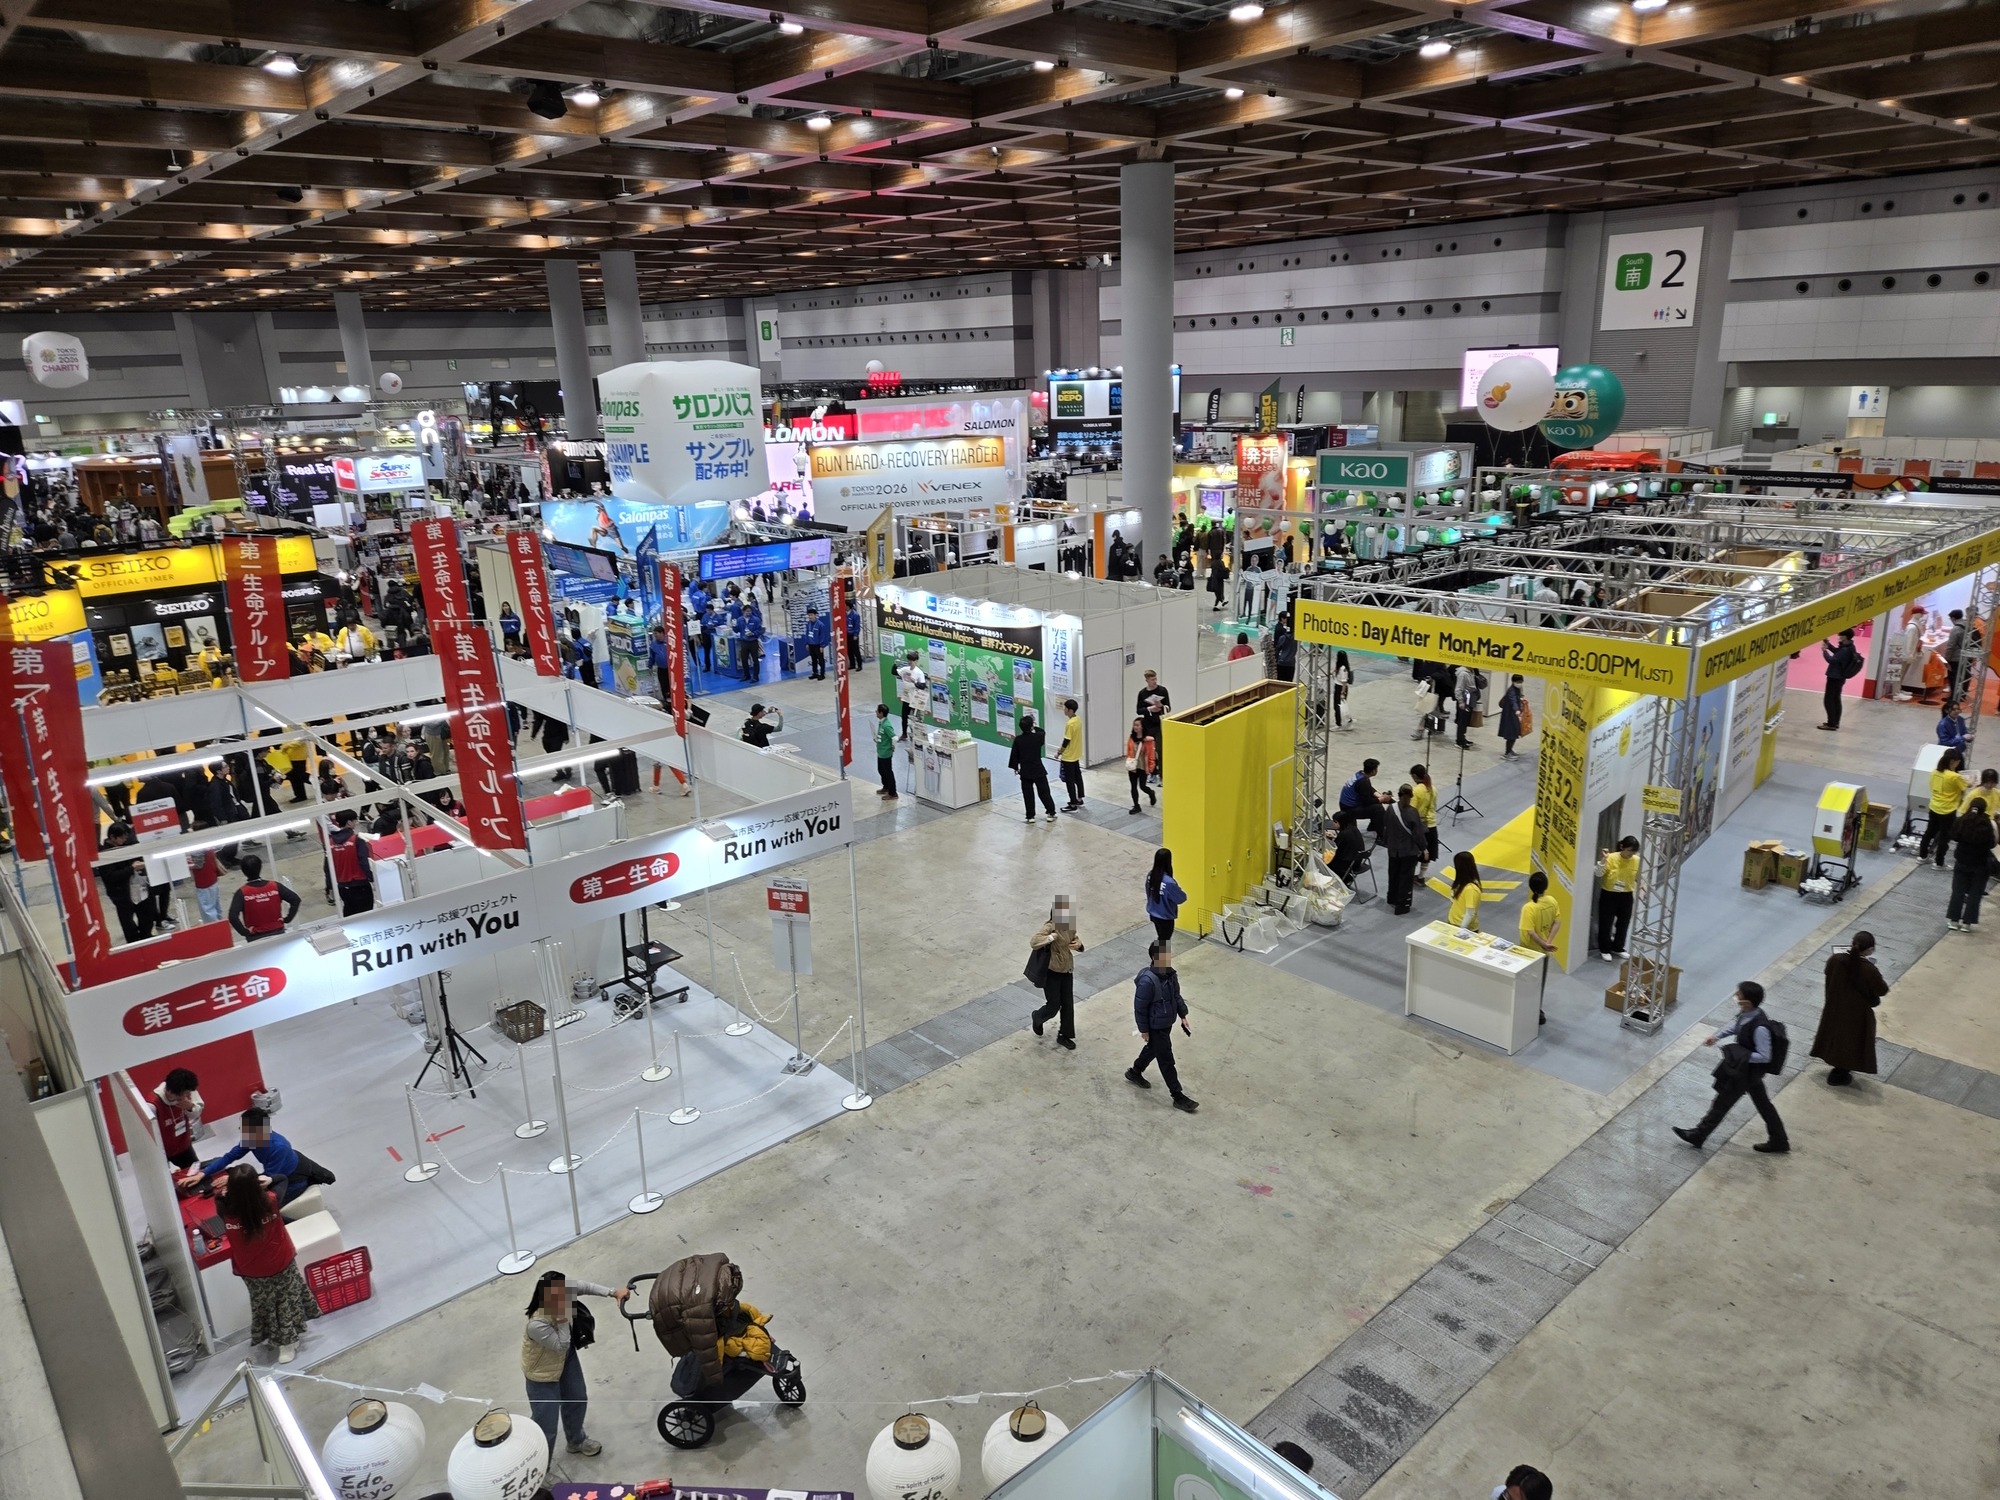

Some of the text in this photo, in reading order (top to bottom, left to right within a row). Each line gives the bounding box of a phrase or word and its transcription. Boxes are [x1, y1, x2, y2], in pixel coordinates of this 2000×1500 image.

[1626, 257, 1644, 265] South
[1661, 249, 1686, 288] 2
[1625, 267, 1642, 287] 南
[42, 364, 80, 372] CHARITY
[673, 392, 754, 420] サロンパス
[1058, 394, 1083, 402] DEPO
[600, 400, 640, 421] lonpas
[963, 418, 1016, 432] SALOMON
[764, 426, 844, 443] LOMON
[686, 437, 755, 461] サンプル
[1248, 446, 1279, 465] 発汗
[380, 462, 411, 472] SUPER
[816, 445, 999, 473] RUN HARD RECOVERY HARDER
[286, 463, 315, 477] Real
[317, 463, 334, 475] En
[369, 470, 408, 479] SPORTS
[695, 459, 749, 481] 配布中!
[930, 481, 982, 492] VENEX
[1752, 475, 1785, 483] MARATHON
[876, 483, 908, 495] 2026
[840, 495, 984, 512] OFFICIAL RECOVERY WEAR PARTNER
[619, 510, 669, 525] Salonpas
[89, 556, 171, 577] SEIKO
[93, 574, 175, 589] OFFICIAL TIMER
[281, 585, 321, 598] ROSPEX
[12, 600, 50, 624] IKO
[155, 599, 209, 616] SEIKO
[238, 541, 276, 677] 第一生命グループ
[903, 621, 923, 633] World
[923, 624, 952, 639] Marathon
[952, 630, 975, 645] Majors
[981, 637, 1034, 656] 世界7大マラソン
[1302, 612, 1350, 636] Photos
[1362, 620, 1389, 646] Day
[1391, 624, 1431, 648] After
[1512, 642, 1525, 662] 2
[1525, 651, 1566, 668] Around
[1705, 644, 1747, 678] OFFICIAL
[1749, 633, 1779, 660] PHOTO
[1779, 615, 1817, 646] SERVICE
[1854, 593, 1875, 615] Photos
[1643, 799, 1679, 810] Reception
[735, 801, 840, 838] 市民ランナー応援プロジェクト
[724, 815, 840, 864] Run with You
[581, 857, 670, 900] 第一生命
[349, 893, 518, 949] 全国市民ランナー応援プロジェクト
[351, 910, 520, 977] Run with You
[140, 974, 272, 1031] 第一生命
[371, 1459, 390, 1467] Tokyo
[504, 1466, 519, 1479] Spirit
[335, 1484, 394, 1500] Tokyo
[906, 1480, 923, 1490] Spirit
